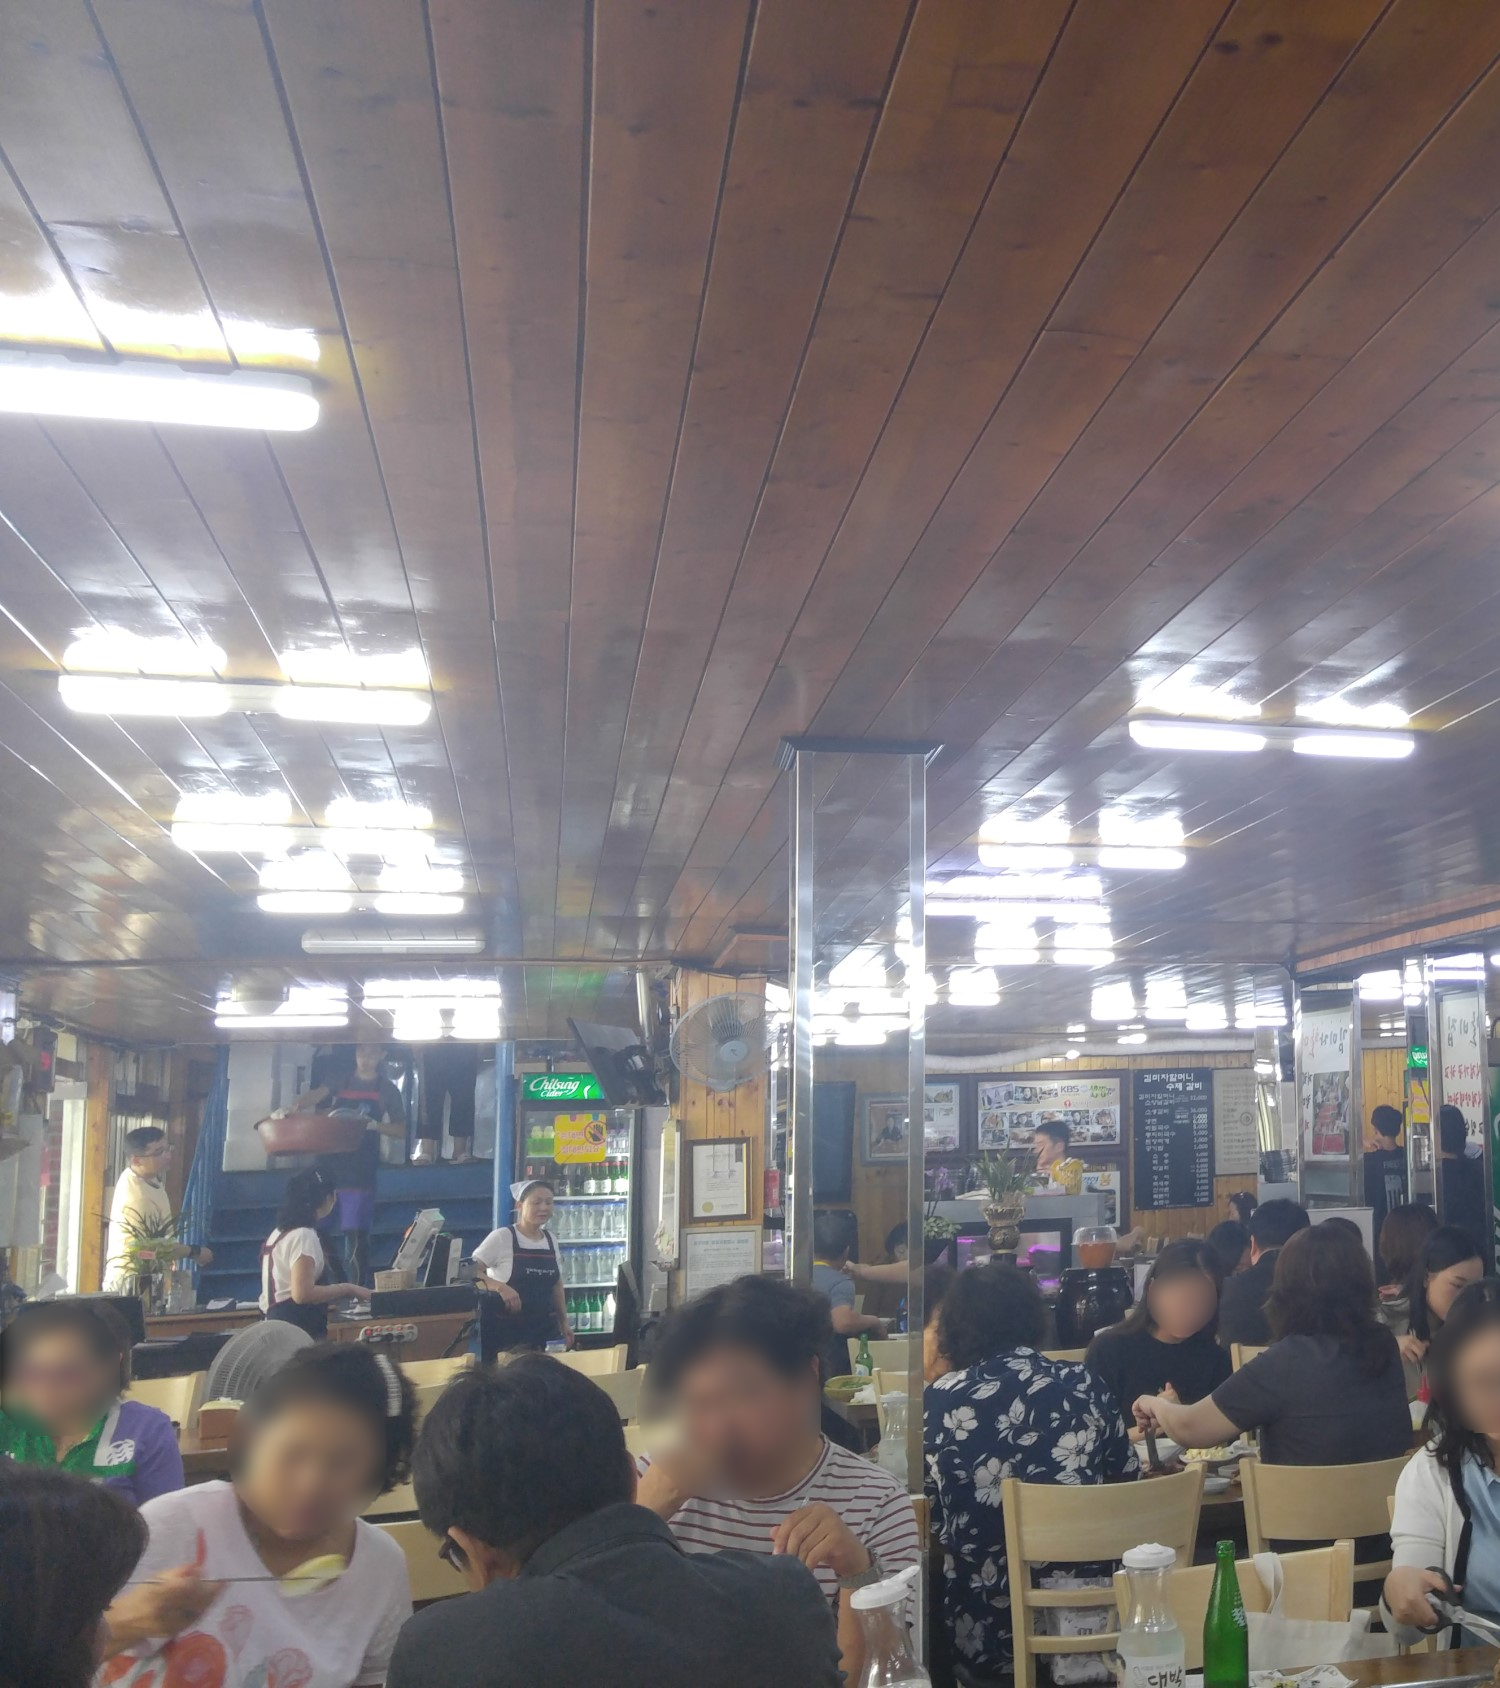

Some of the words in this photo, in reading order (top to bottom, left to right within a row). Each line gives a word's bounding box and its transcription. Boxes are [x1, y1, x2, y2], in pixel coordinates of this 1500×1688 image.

[529, 1076, 581, 1096] Chilsung
[1060, 1085, 1080, 1093] KBS
[1186, 1082, 1202, 1091] 갈비
[540, 1090, 565, 1098] Cider
